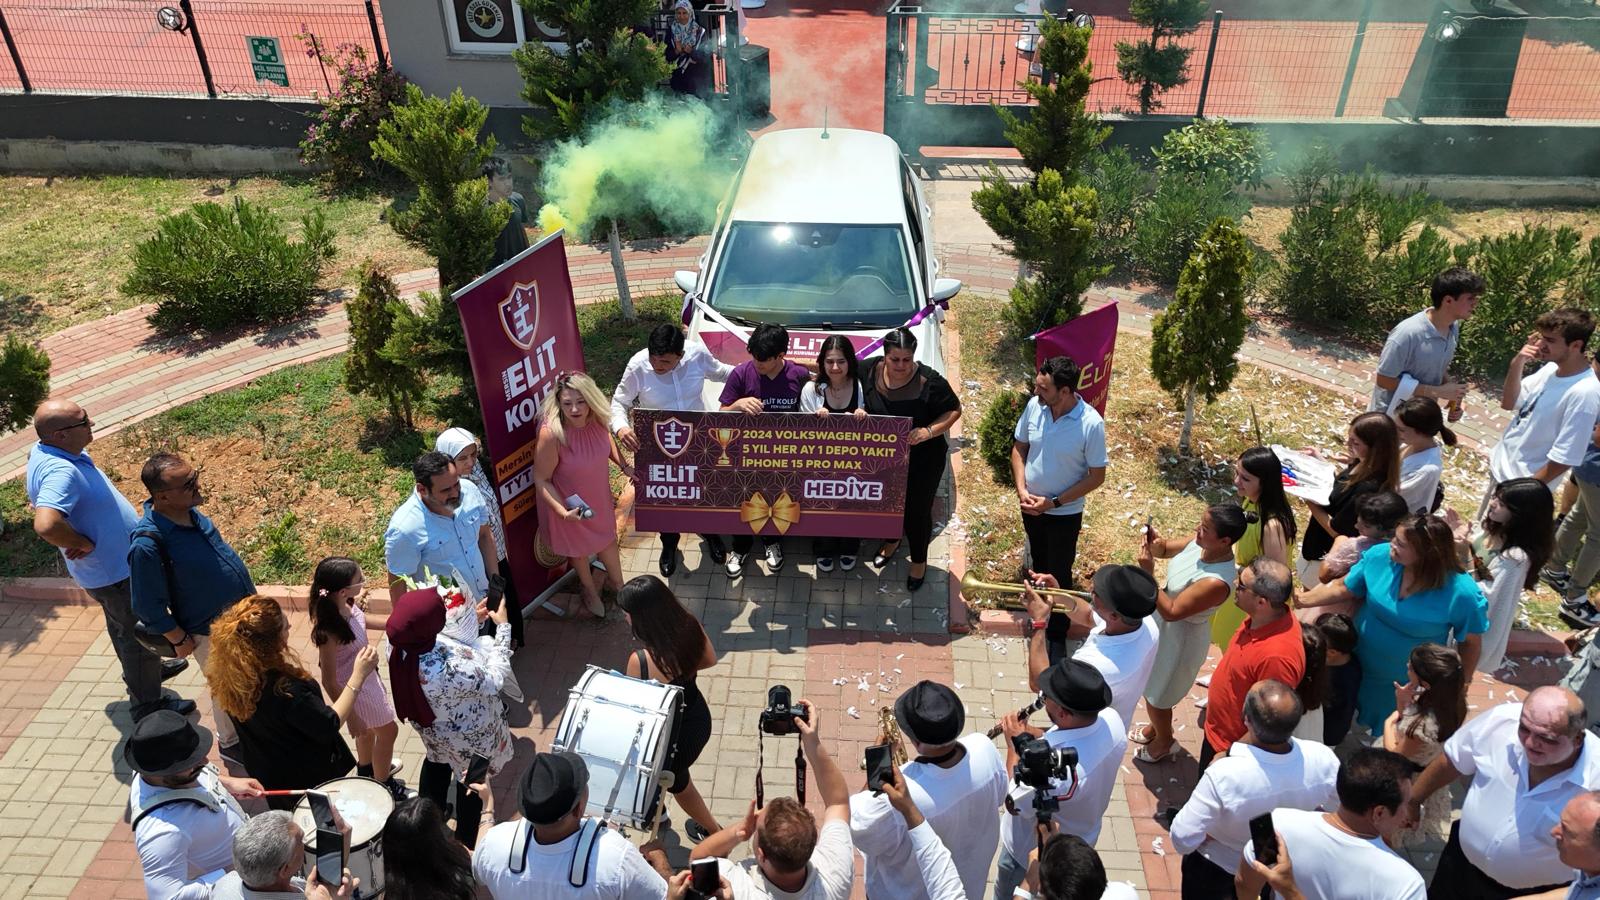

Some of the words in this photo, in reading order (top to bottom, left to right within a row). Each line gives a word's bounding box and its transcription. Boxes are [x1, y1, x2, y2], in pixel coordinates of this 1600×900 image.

[743, 430, 772, 439] 2024
[775, 430, 861, 442] VOLKSWAGEN
[864, 434, 897, 443] POLO
[742, 444, 750, 454] 5
[752, 444, 770, 454] YIL
[773, 444, 798, 455] HER
[800, 445, 816, 455] AY
[818, 445, 823, 455] 1
[826, 446, 858, 456] DEPO
[861, 447, 896, 458] YAKIT
[742, 456, 788, 468] İPHONE
[791, 459, 803, 468] 15
[806, 460, 831, 469] PRO
[833, 460, 862, 469] MAX
[504, 469, 531, 495] TYT
[806, 477, 882, 499] HEDİYE
